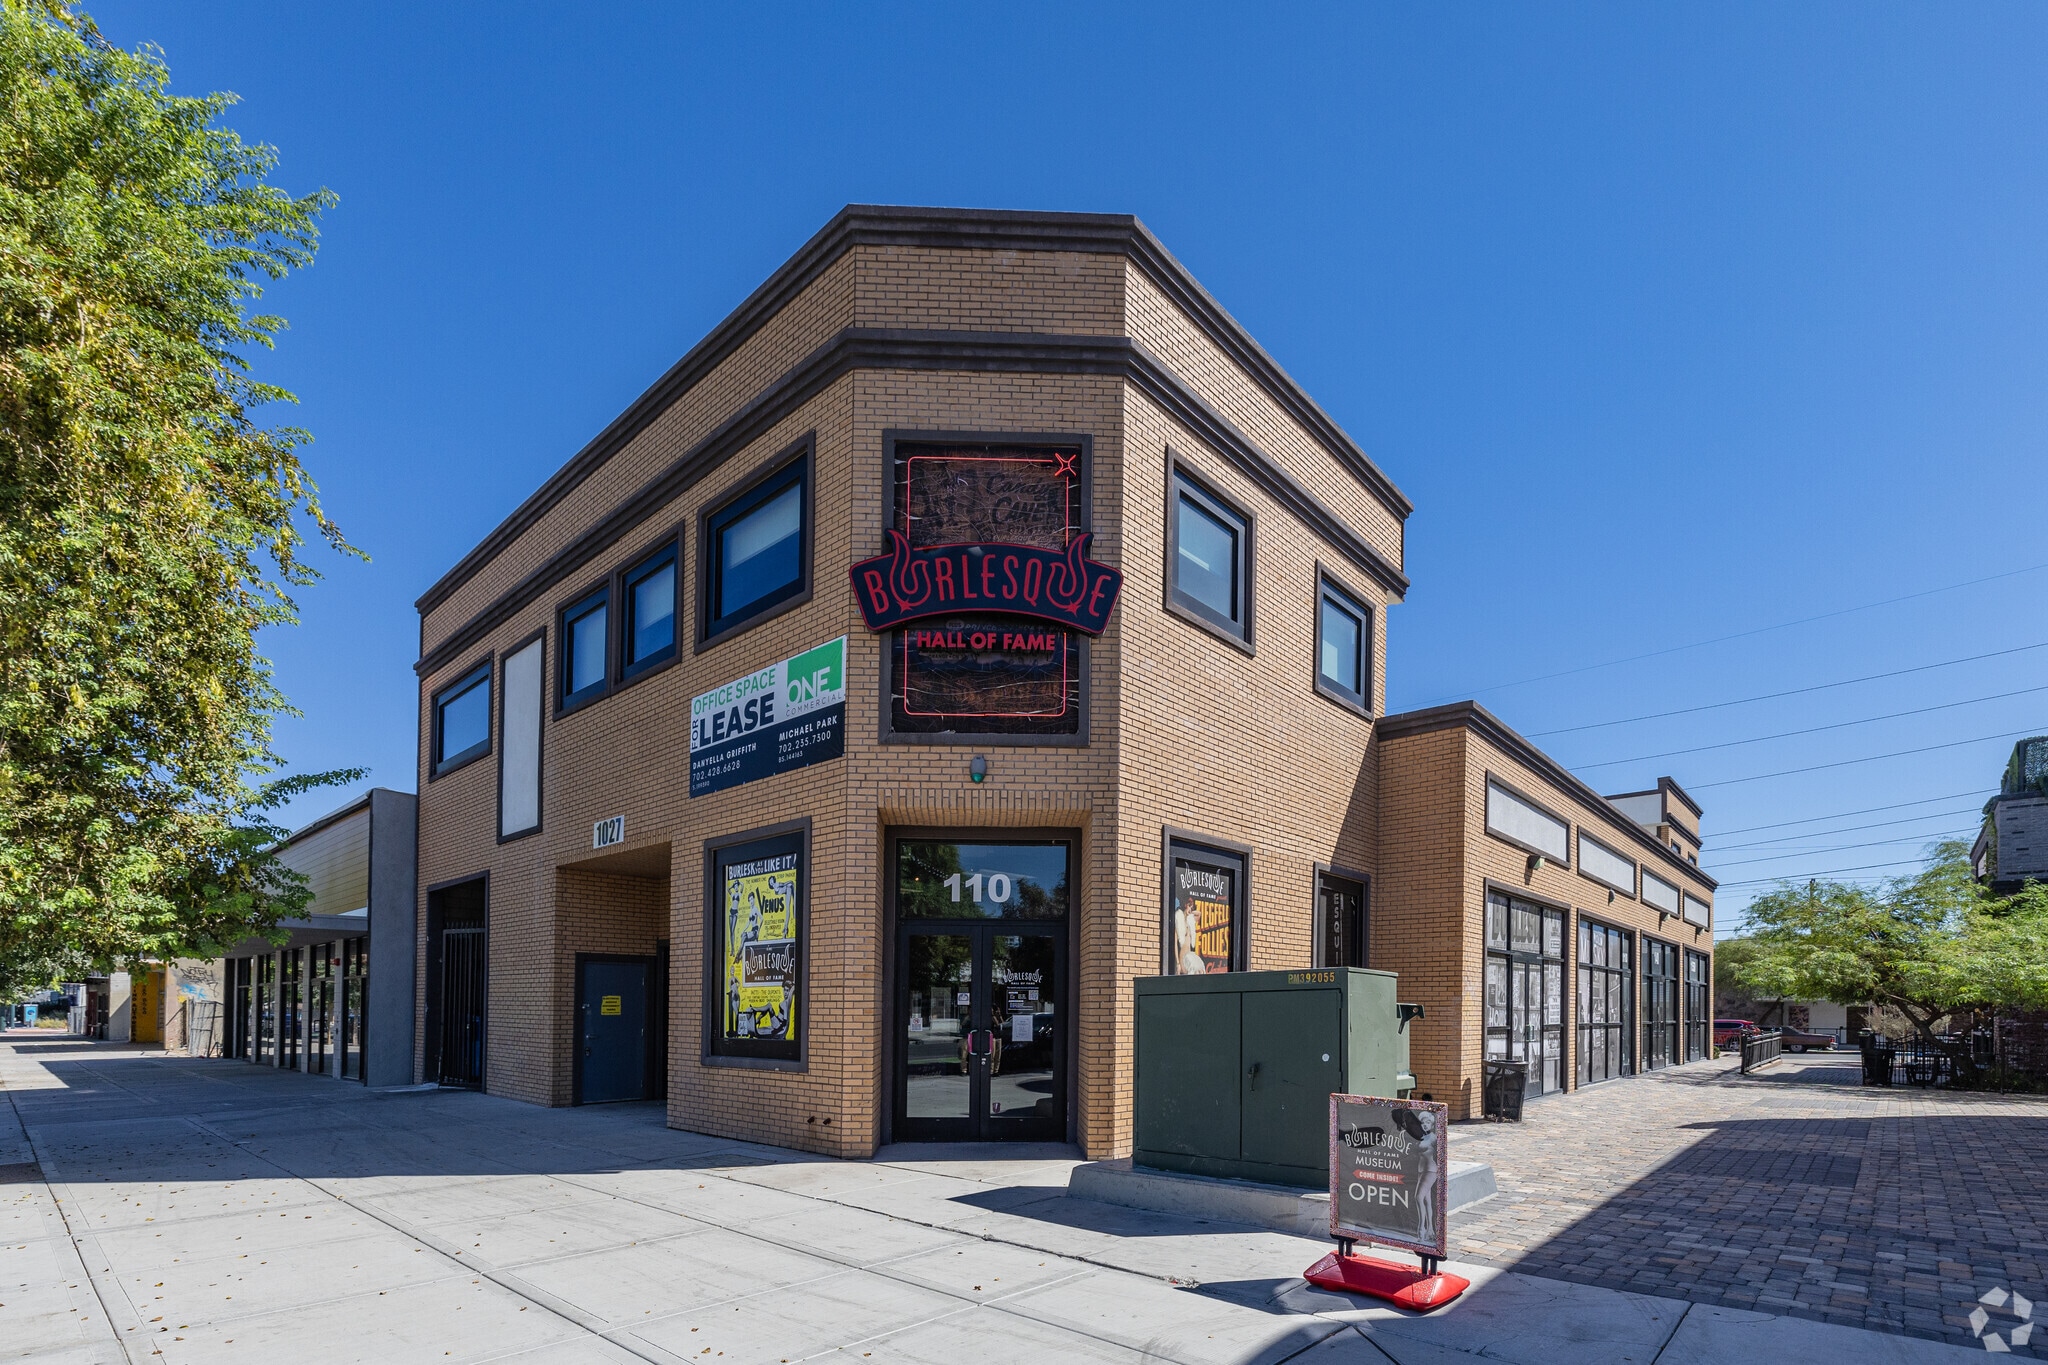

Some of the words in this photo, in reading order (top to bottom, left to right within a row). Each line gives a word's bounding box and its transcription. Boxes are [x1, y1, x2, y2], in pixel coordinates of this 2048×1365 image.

[863, 529, 1112, 618] BURLESQUE
[917, 631, 966, 649] HALL
[970, 631, 997, 650] OF
[1003, 633, 1056, 651] FAME
[693, 686, 733, 715] OFFICE
[735, 668, 776, 699] SPACE
[787, 665, 831, 704] ONE
[785, 692, 842, 717] COMMERCIAL
[699, 691, 775, 747] LEASE
[778, 723, 814, 741] MICHAEL
[816, 715, 838, 730] PARK
[691, 718, 699, 750] FOR
[692, 753, 724, 770] DANYELLA
[726, 742, 757, 759] GRIFFITH
[692, 759, 741, 782] 702.428.6628
[596, 818, 622, 846] 1027
[728, 862, 755, 880] BURLESK
[764, 858, 780, 873] LIKE
[782, 852, 797, 870] IT!
[1180, 861, 1225, 896] BURLESQUE
[943, 873, 1012, 903] 110
[1194, 926, 1230, 957] FOLLIES
[745, 944, 795, 976] BURLESQUE
[1287, 971, 1335, 984] PM392055
[1344, 1122, 1413, 1156] BURLESQUE
[1355, 1155, 1402, 1170] MUSEUM
[1359, 1171, 1376, 1180] COME
[1348, 1182, 1409, 1209] OPEN
